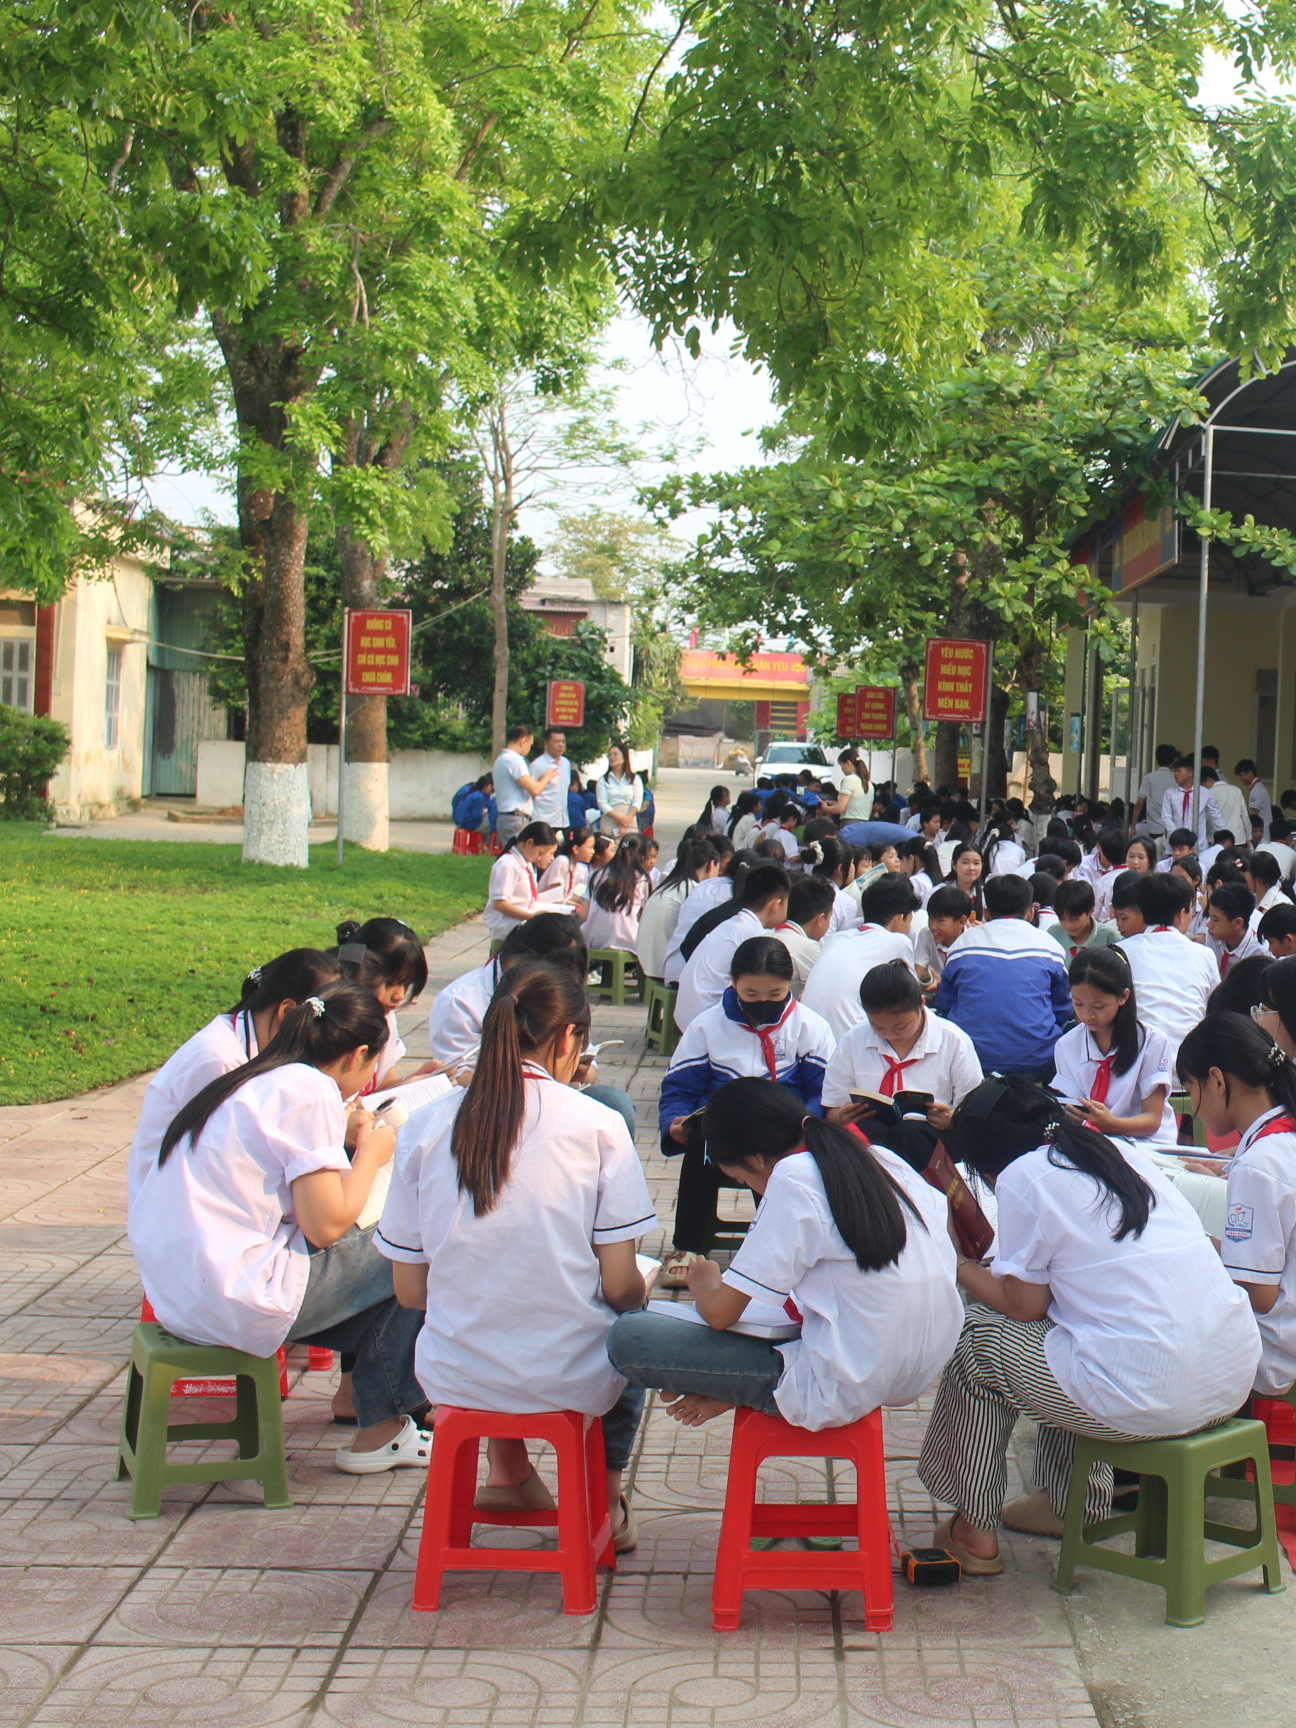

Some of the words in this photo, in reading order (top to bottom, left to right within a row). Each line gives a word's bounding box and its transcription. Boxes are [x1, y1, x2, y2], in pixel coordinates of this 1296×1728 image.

[366, 617, 384, 630] KHÔNG
[385, 618, 392, 631] CÓ
[361, 636, 372, 650] HỌC
[372, 637, 385, 648] SINH
[941, 646, 954, 658] YÊU
[955, 647, 974, 659] NƯỚC
[367, 652, 375, 665] CÓ
[375, 654, 386, 668] HỌC
[387, 654, 400, 666] SINH
[941, 662, 956, 675] HIẾU
[958, 666, 972, 678] HỌC
[938, 679, 954, 692] KÍNH
[938, 695, 953, 708] MẾN
